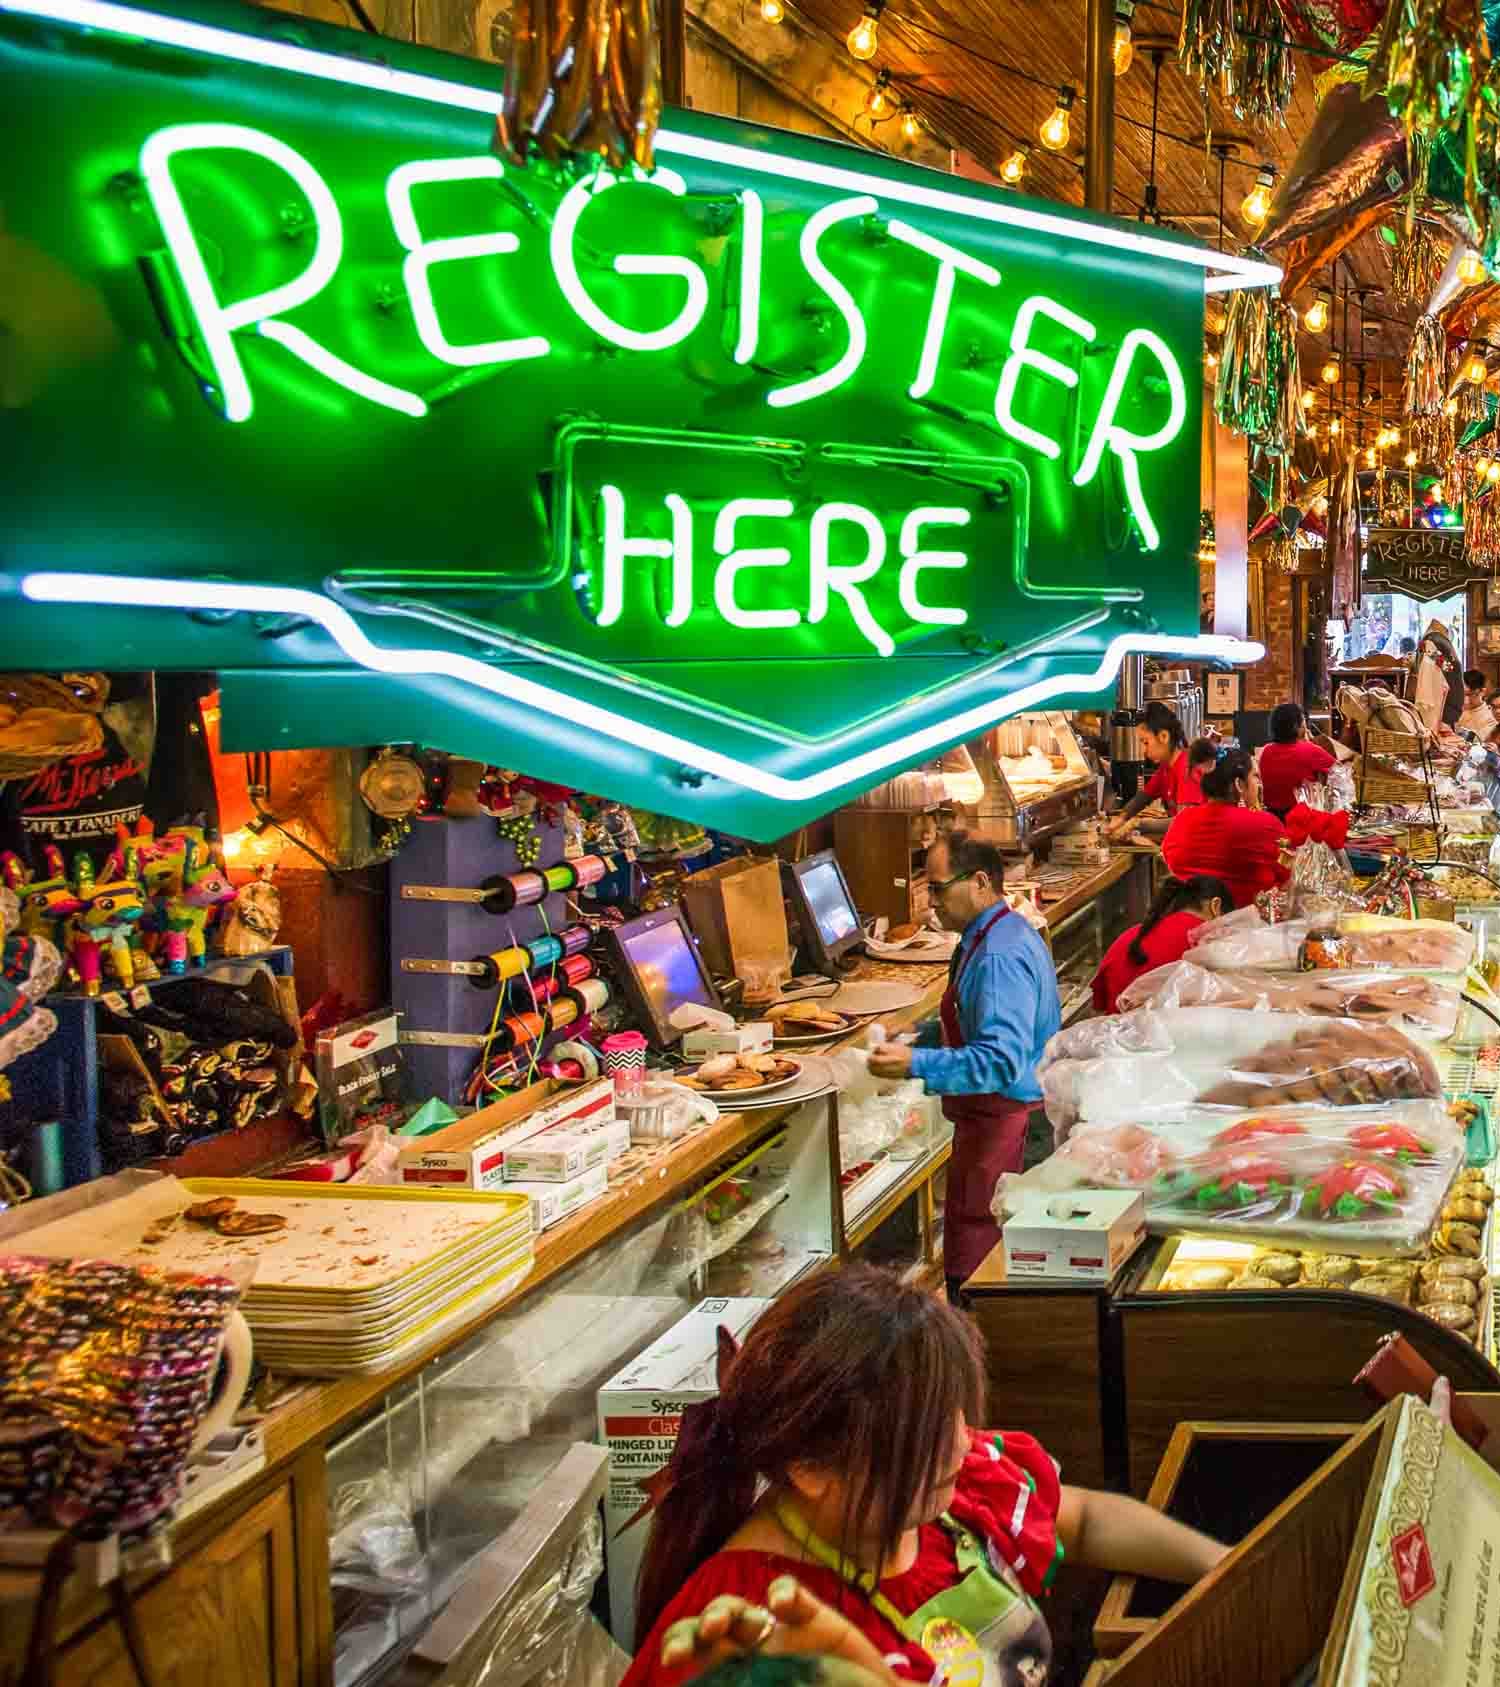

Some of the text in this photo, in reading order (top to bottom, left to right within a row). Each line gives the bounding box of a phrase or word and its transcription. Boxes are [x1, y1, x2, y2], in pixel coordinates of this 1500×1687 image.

[140, 123, 1188, 551] REGISTER
[598, 484, 971, 658] HERE
[1408, 565, 1450, 584] HERE
[420, 1157, 448, 1169] Sysco
[609, 1440, 655, 1450] HINGED
